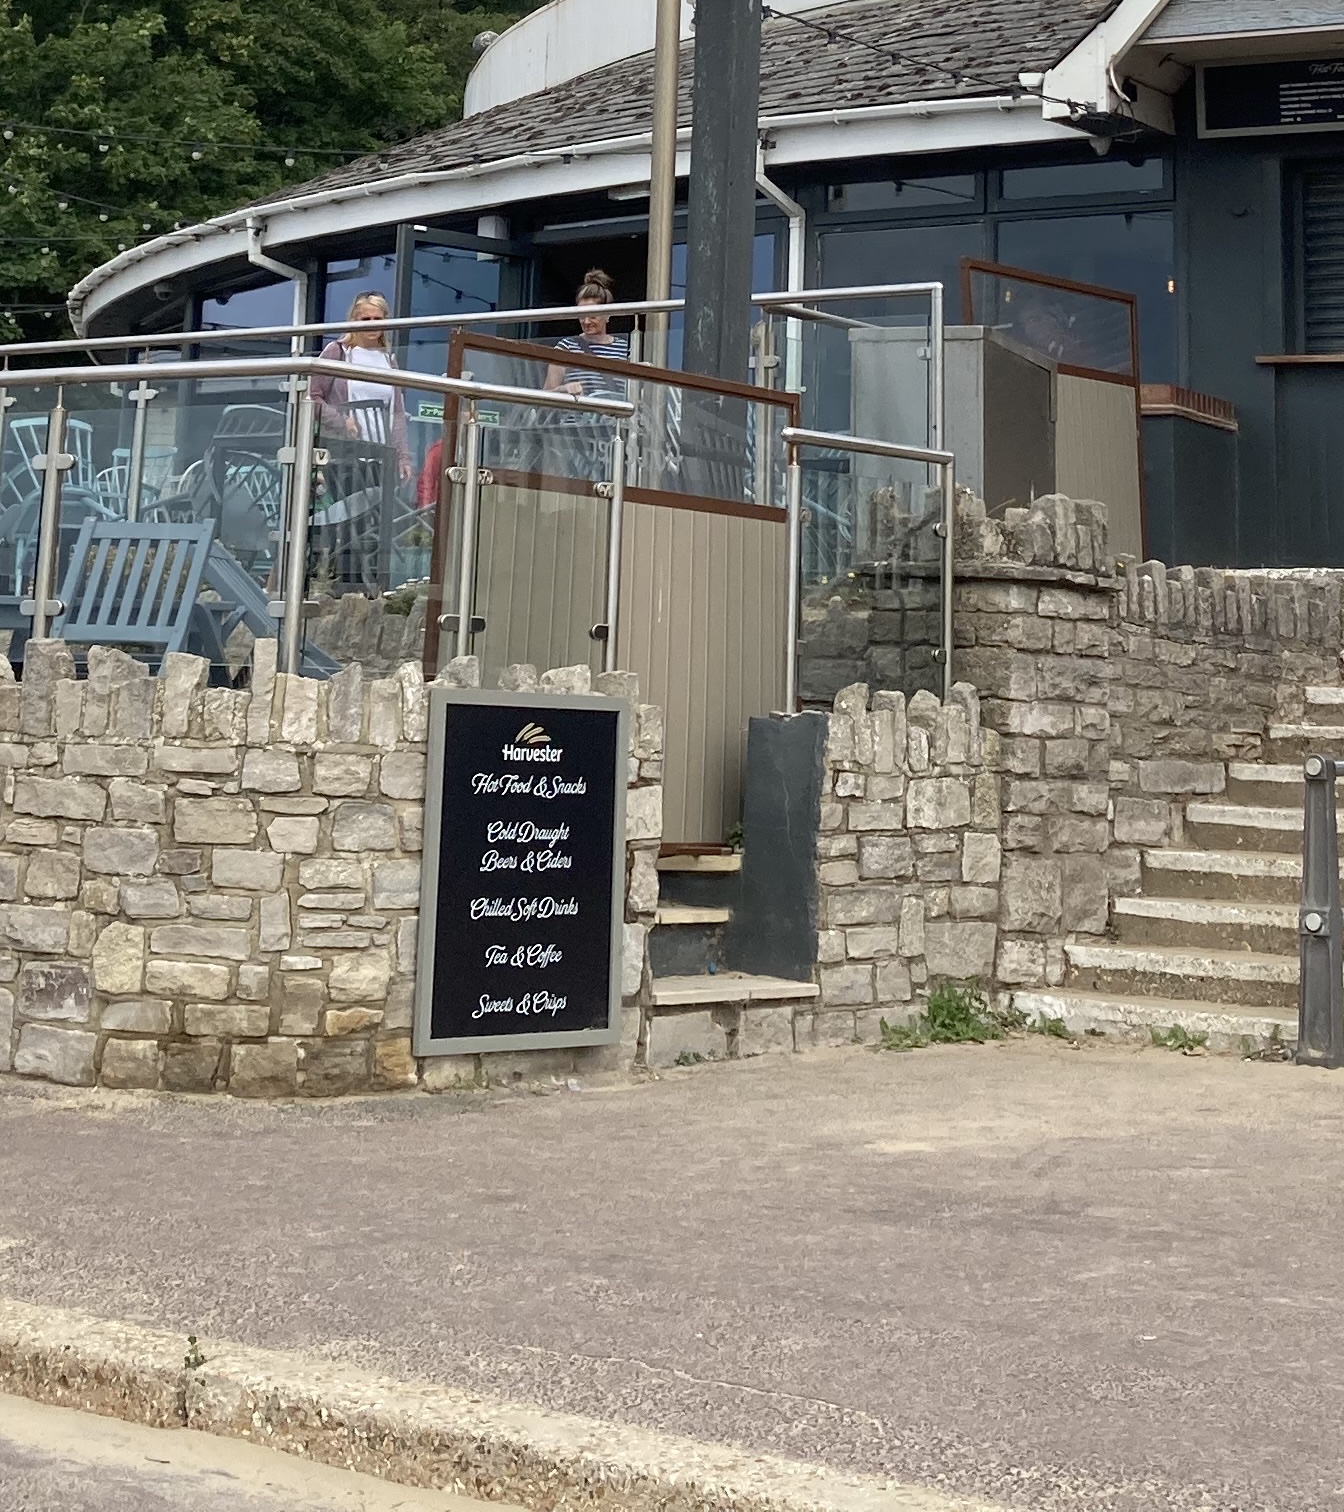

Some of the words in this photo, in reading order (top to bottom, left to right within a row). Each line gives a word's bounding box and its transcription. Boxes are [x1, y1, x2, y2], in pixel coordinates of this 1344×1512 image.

[502, 743, 563, 762] Harvester
[471, 773, 498, 795] Hot
[499, 774, 534, 796] Food
[533, 776, 547, 798] &
[546, 776, 587, 799] Snacks
[487, 821, 519, 843] Cold
[517, 821, 570, 849] Draught
[480, 849, 517, 872] Beers
[520, 851, 535, 873] &
[536, 849, 572, 872] Ciders
[470, 897, 515, 920] Chilled
[511, 897, 538, 922] Soft
[537, 896, 579, 919] Drinks
[485, 945, 508, 968] Tea
[510, 946, 525, 968] &
[526, 944, 563, 968] Coffee
[472, 994, 514, 1019] Sweets
[516, 993, 530, 1015] &
[532, 991, 567, 1017] Crisps
